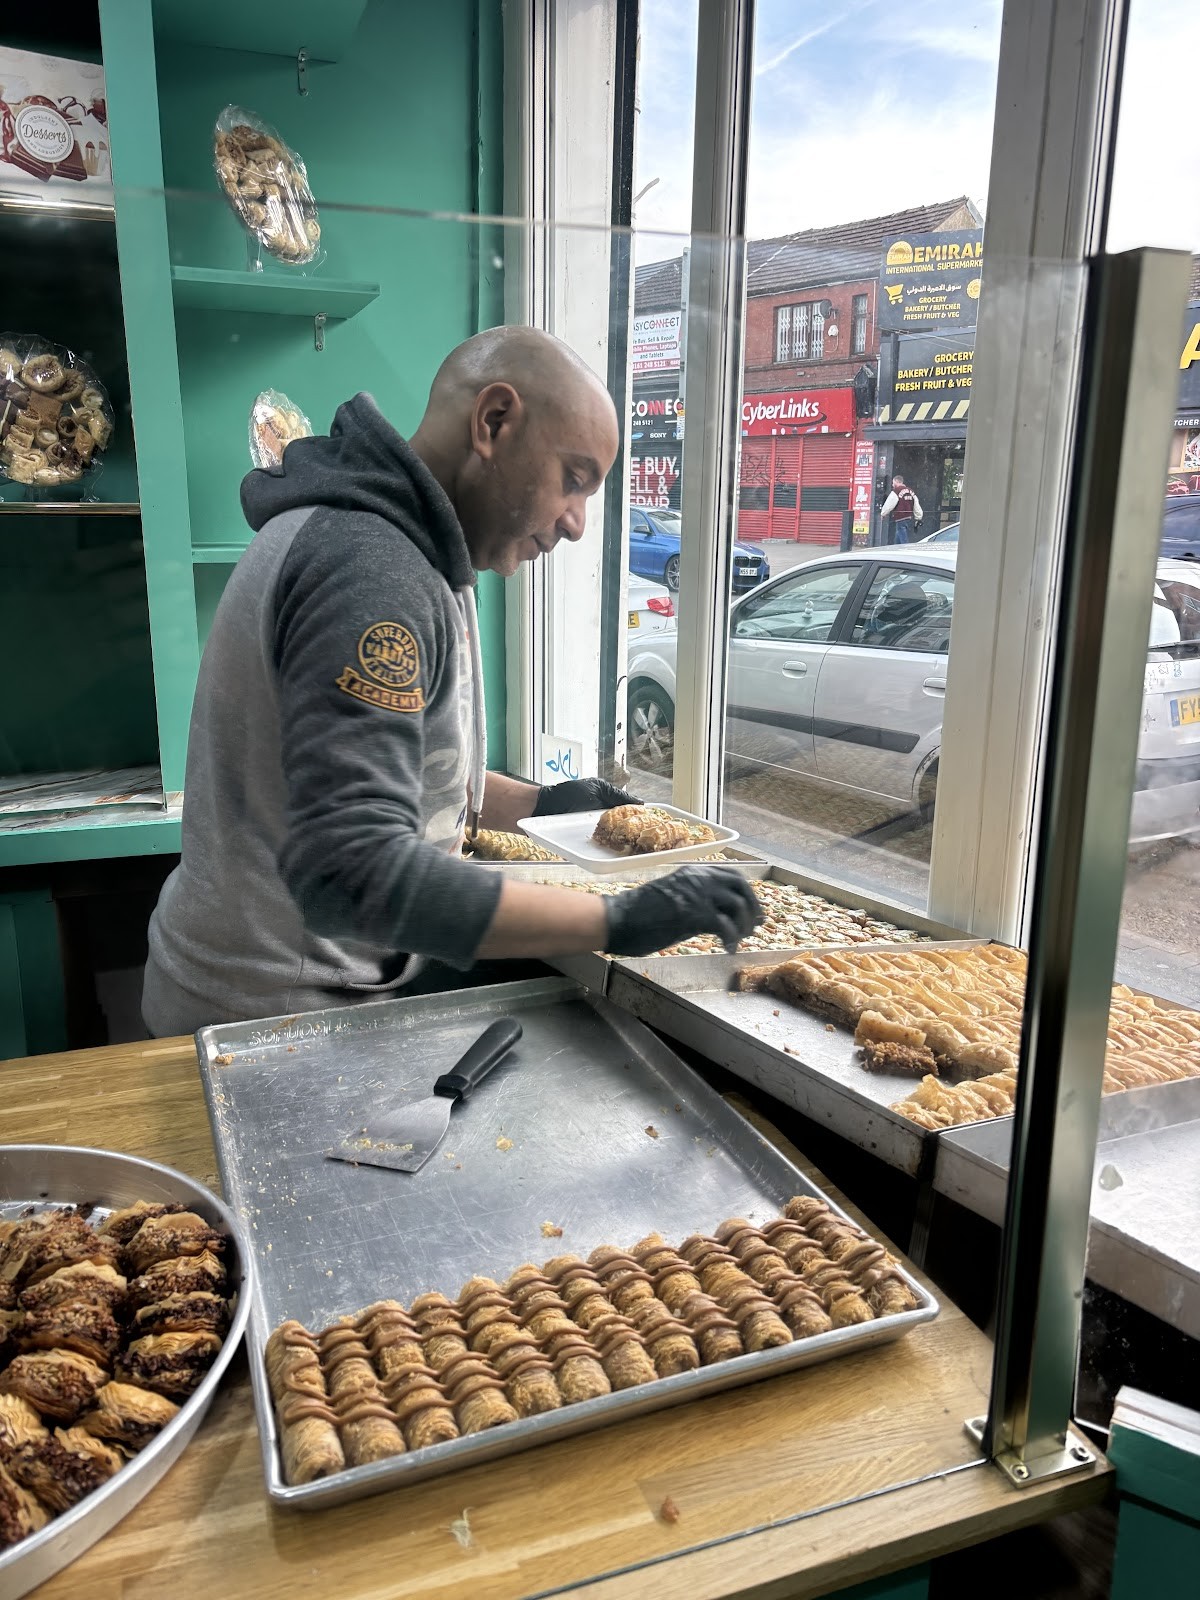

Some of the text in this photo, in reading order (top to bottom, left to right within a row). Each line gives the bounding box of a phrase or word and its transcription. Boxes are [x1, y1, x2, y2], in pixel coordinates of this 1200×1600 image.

[22, 123, 67, 144] Desserts
[886, 259, 983, 275] INTERNATIONAL SUPERMARKE
[919, 296, 947, 304] GROCERY
[948, 310, 960, 318] VEG
[934, 351, 974, 363] GROCERY
[935, 364, 973, 376] BUTCHER
[895, 377, 972, 392] FRESH FRUIT & VEG
[742, 398, 819, 425] CyberLinks
[645, 456, 680, 478] BUY,
[631, 475, 668, 495] ELL &
[370, 626, 416, 656] SUPERDRY
[350, 682, 418, 708] ACADEMY
[1180, 698, 1200, 721] FY
